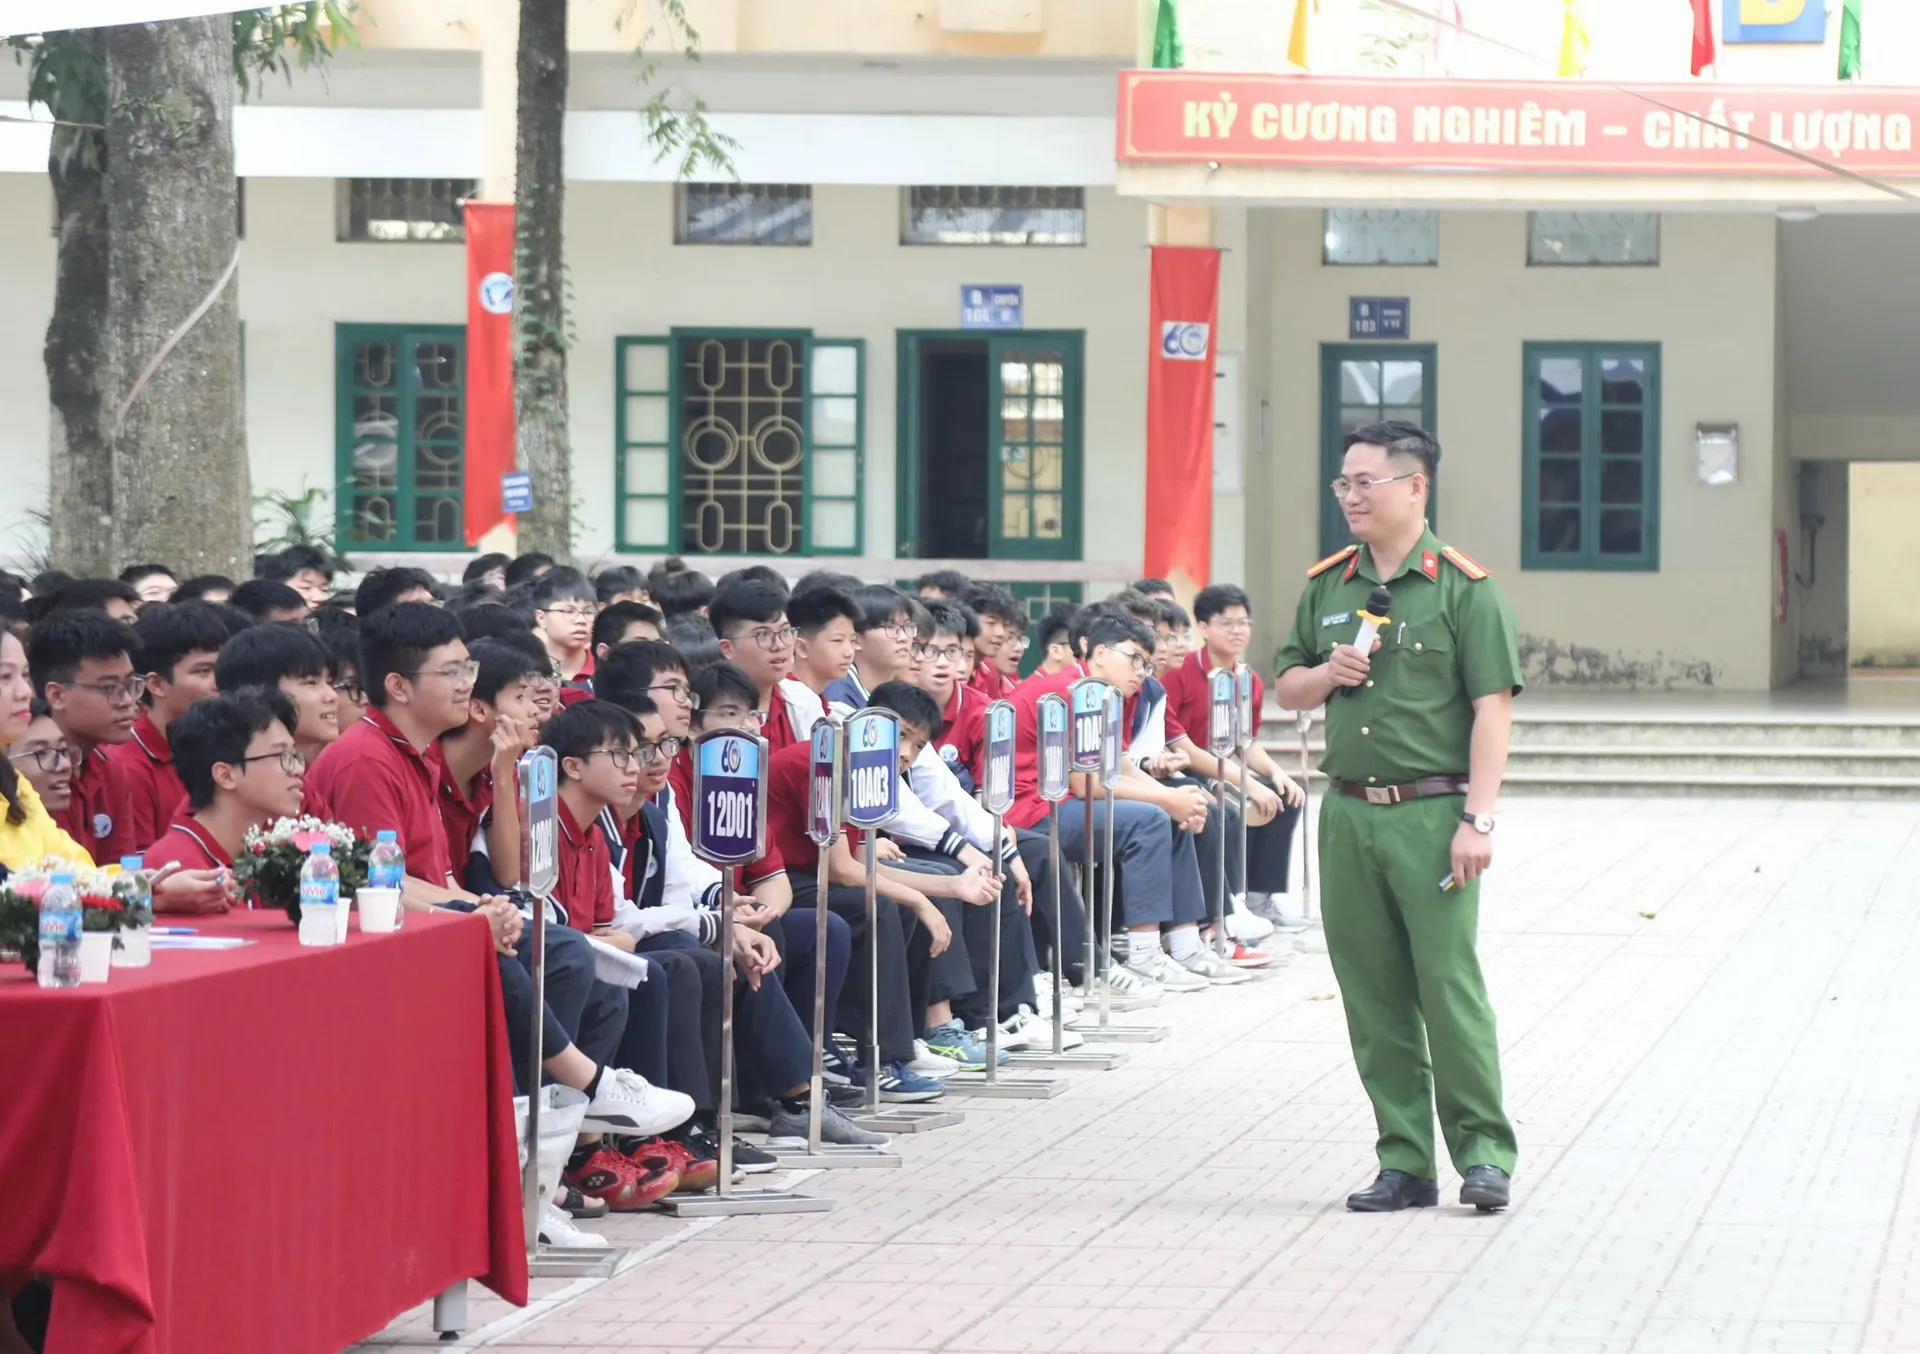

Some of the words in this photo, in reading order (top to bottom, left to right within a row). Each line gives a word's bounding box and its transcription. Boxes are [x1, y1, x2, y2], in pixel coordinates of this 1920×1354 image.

[1251, 101, 1397, 143] CƯƠNG
[1413, 101, 1586, 147] NGHIÊM
[1643, 98, 1754, 150] CHẤT
[1769, 110, 1912, 158] LƯỢNG
[851, 765, 889, 809] 10A03
[707, 790, 753, 839] 12D01
